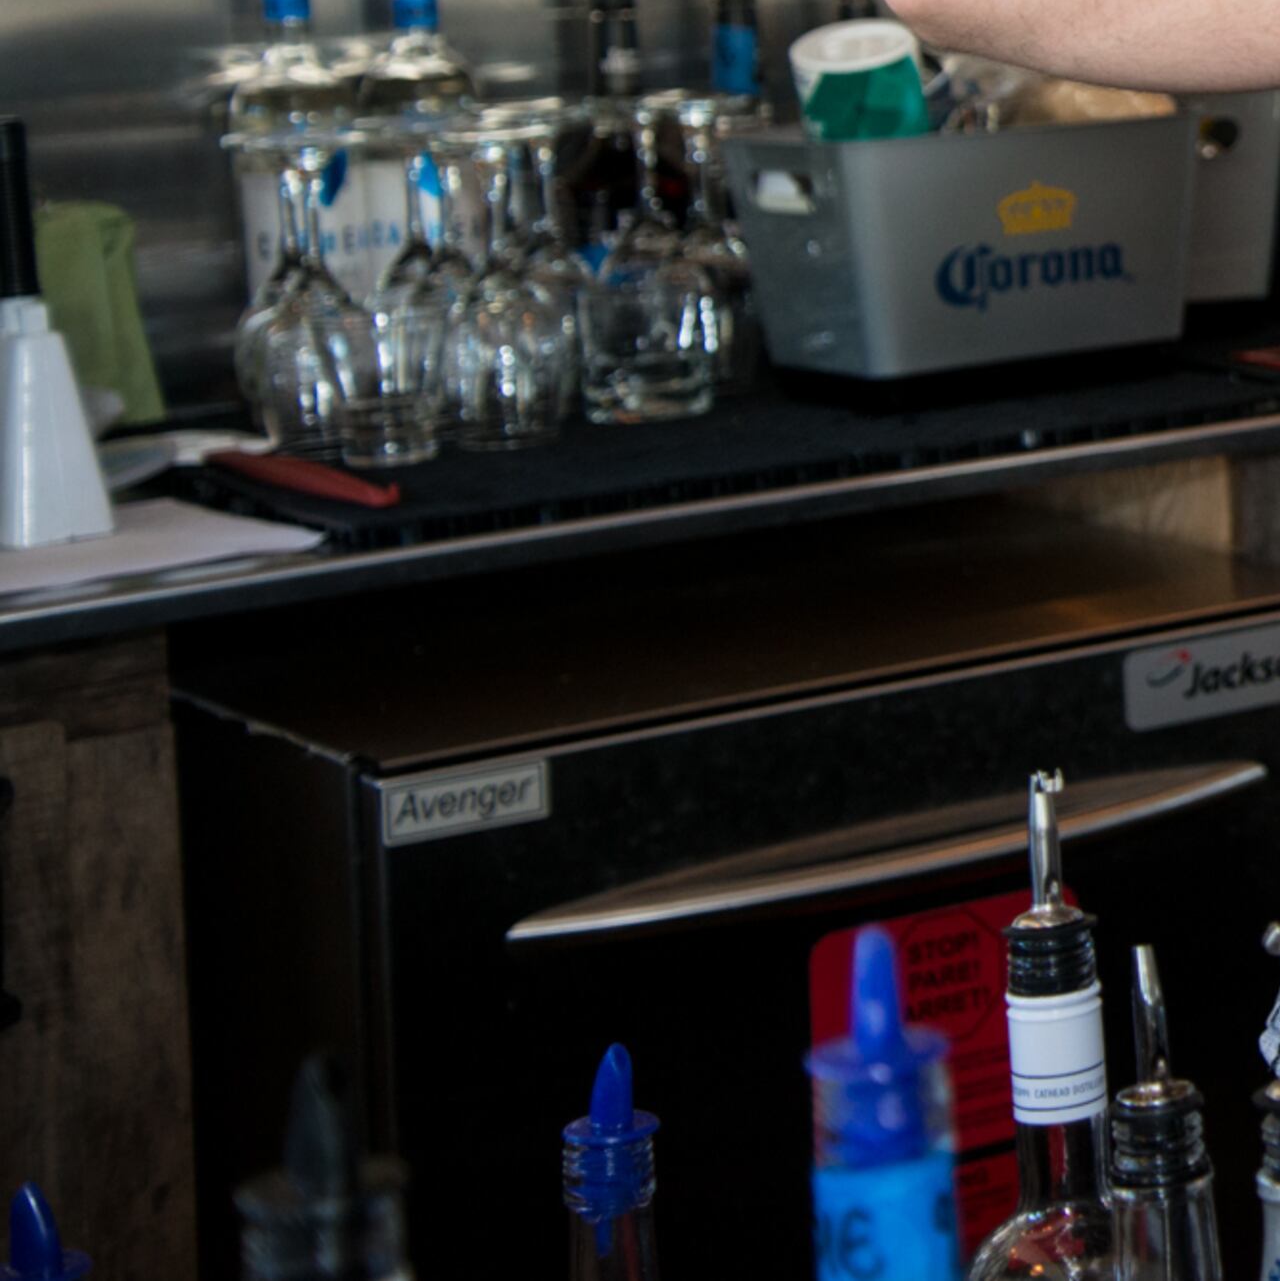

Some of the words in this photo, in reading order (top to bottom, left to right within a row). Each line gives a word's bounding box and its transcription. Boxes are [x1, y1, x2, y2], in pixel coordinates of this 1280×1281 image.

[934, 242, 1124, 311] Corona
[393, 773, 534, 828] Avenger
[906, 928, 979, 966] STOP!
[907, 957, 981, 994] PARE!
[1034, 1085, 1070, 1098] CATHEAD
